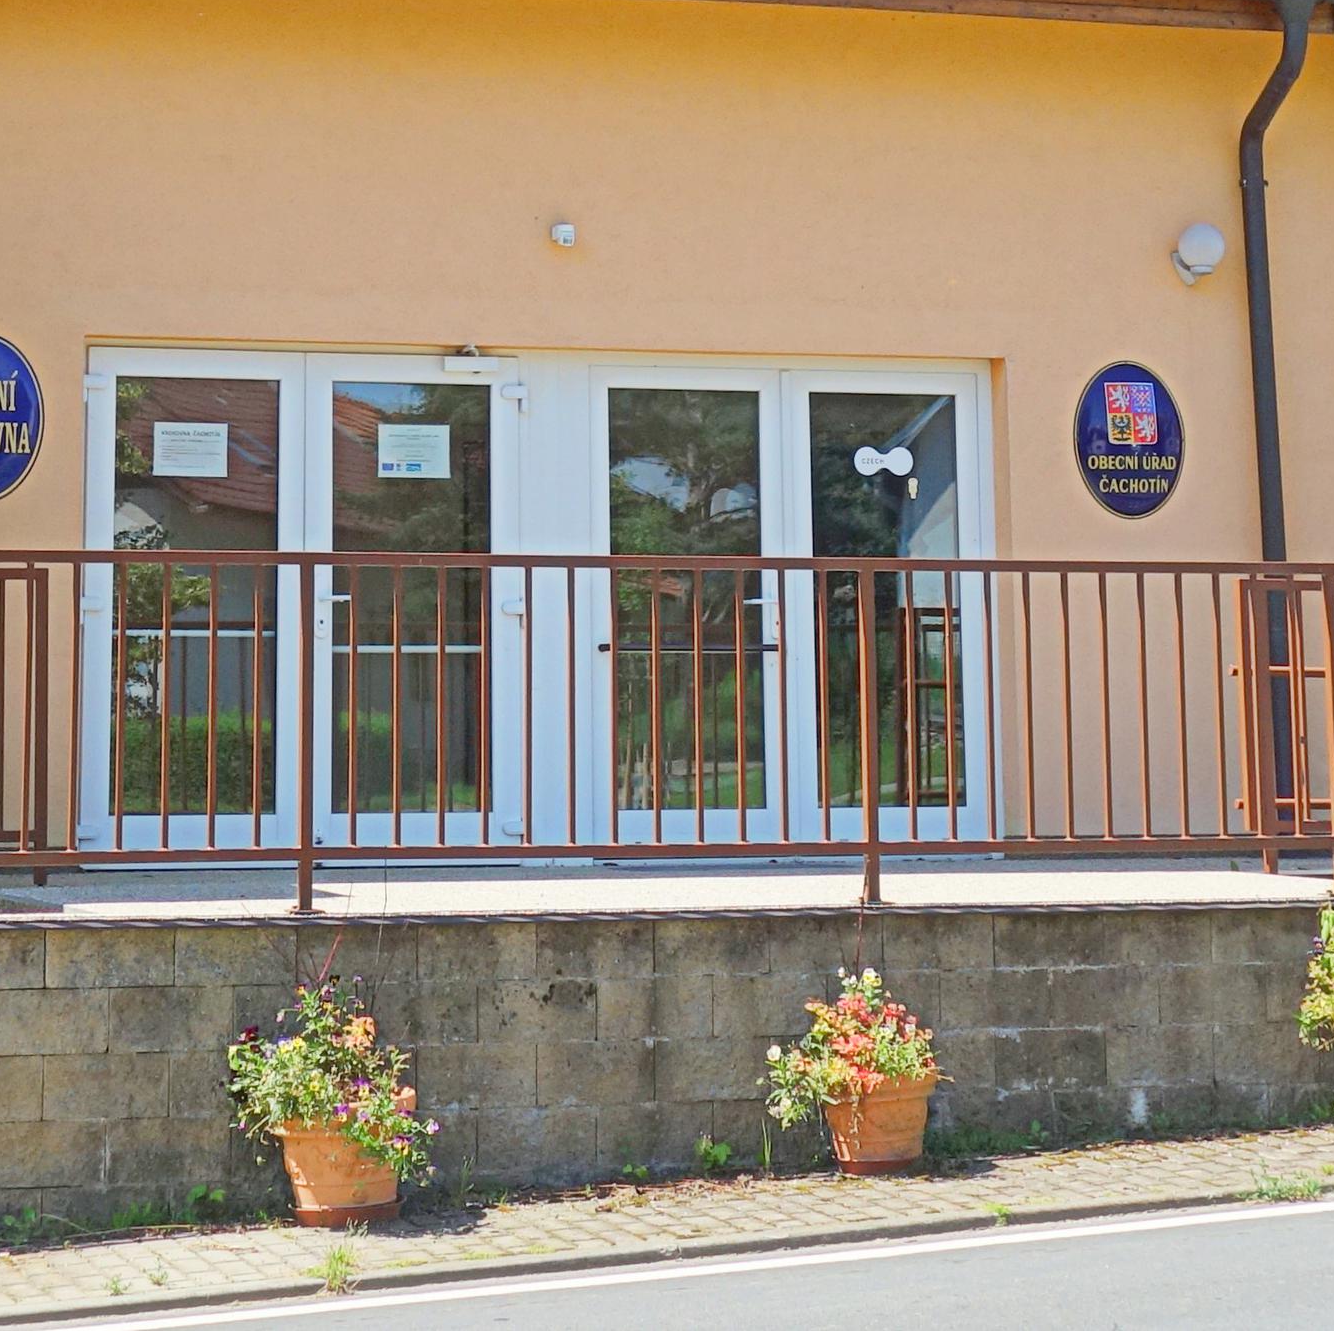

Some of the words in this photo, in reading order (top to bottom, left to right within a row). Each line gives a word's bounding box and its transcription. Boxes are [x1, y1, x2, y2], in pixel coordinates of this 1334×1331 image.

[1087, 451, 1139, 470] OBECNÍ
[1142, 452, 1177, 470] ÚŘAD
[1099, 474, 1169, 494] ČACHOTÍN
